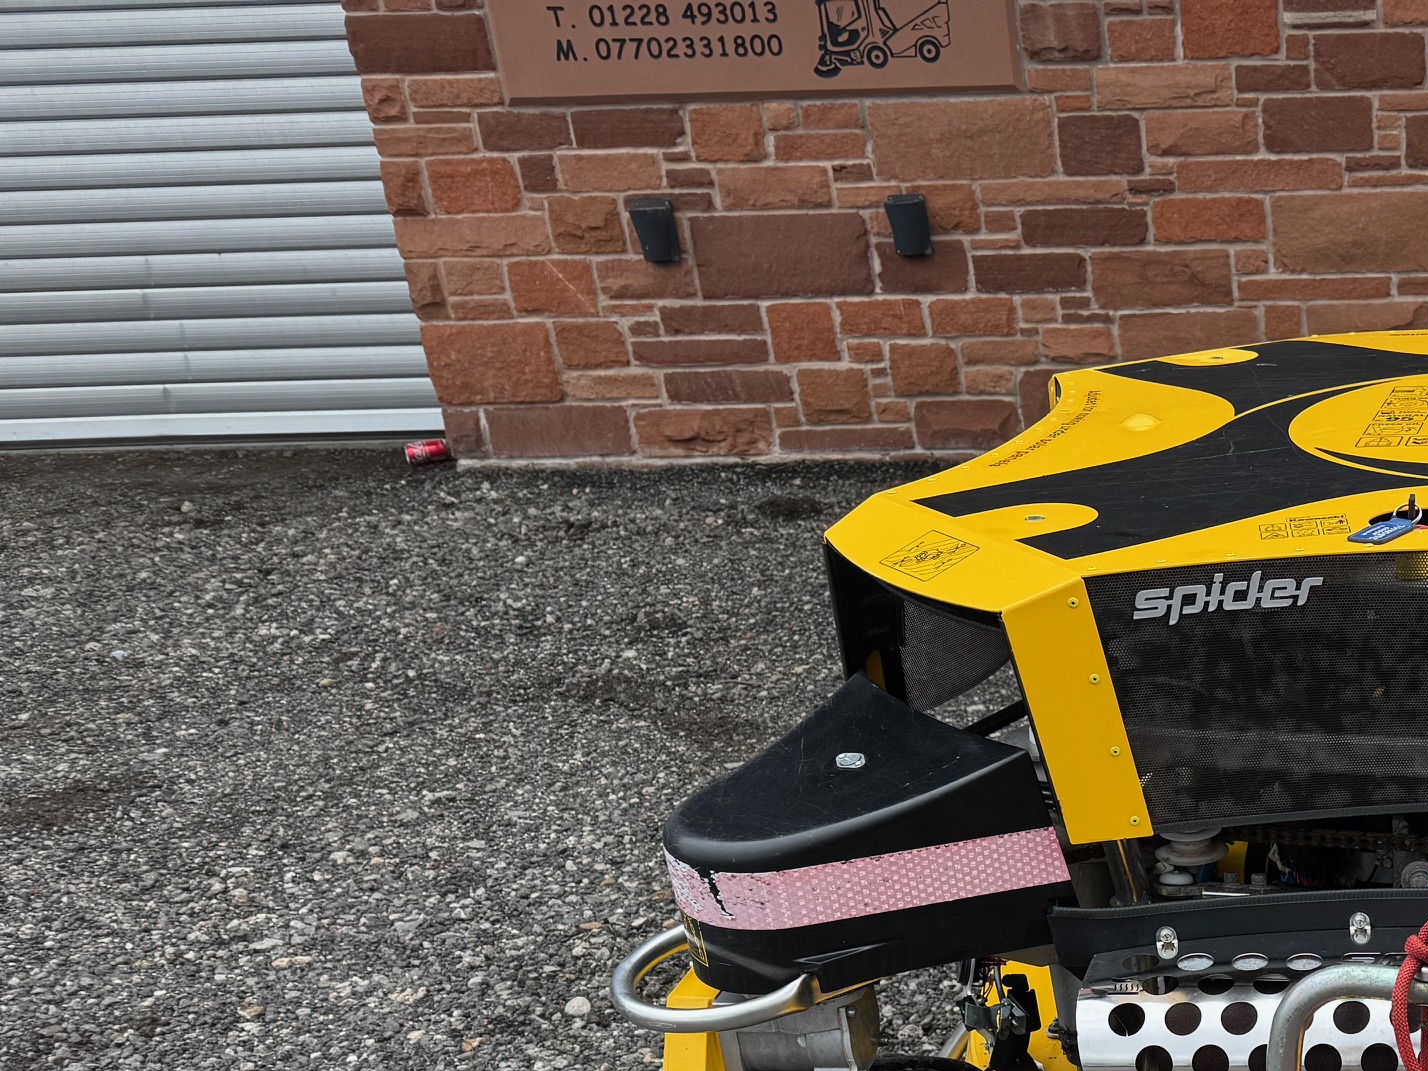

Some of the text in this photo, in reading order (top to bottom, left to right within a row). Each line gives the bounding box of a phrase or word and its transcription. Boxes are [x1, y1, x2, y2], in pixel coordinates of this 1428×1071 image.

[546, 1, 778, 29] T. 01228 493013
[556, 34, 783, 62] M. 07702331800
[1132, 570, 1324, 626] spider
